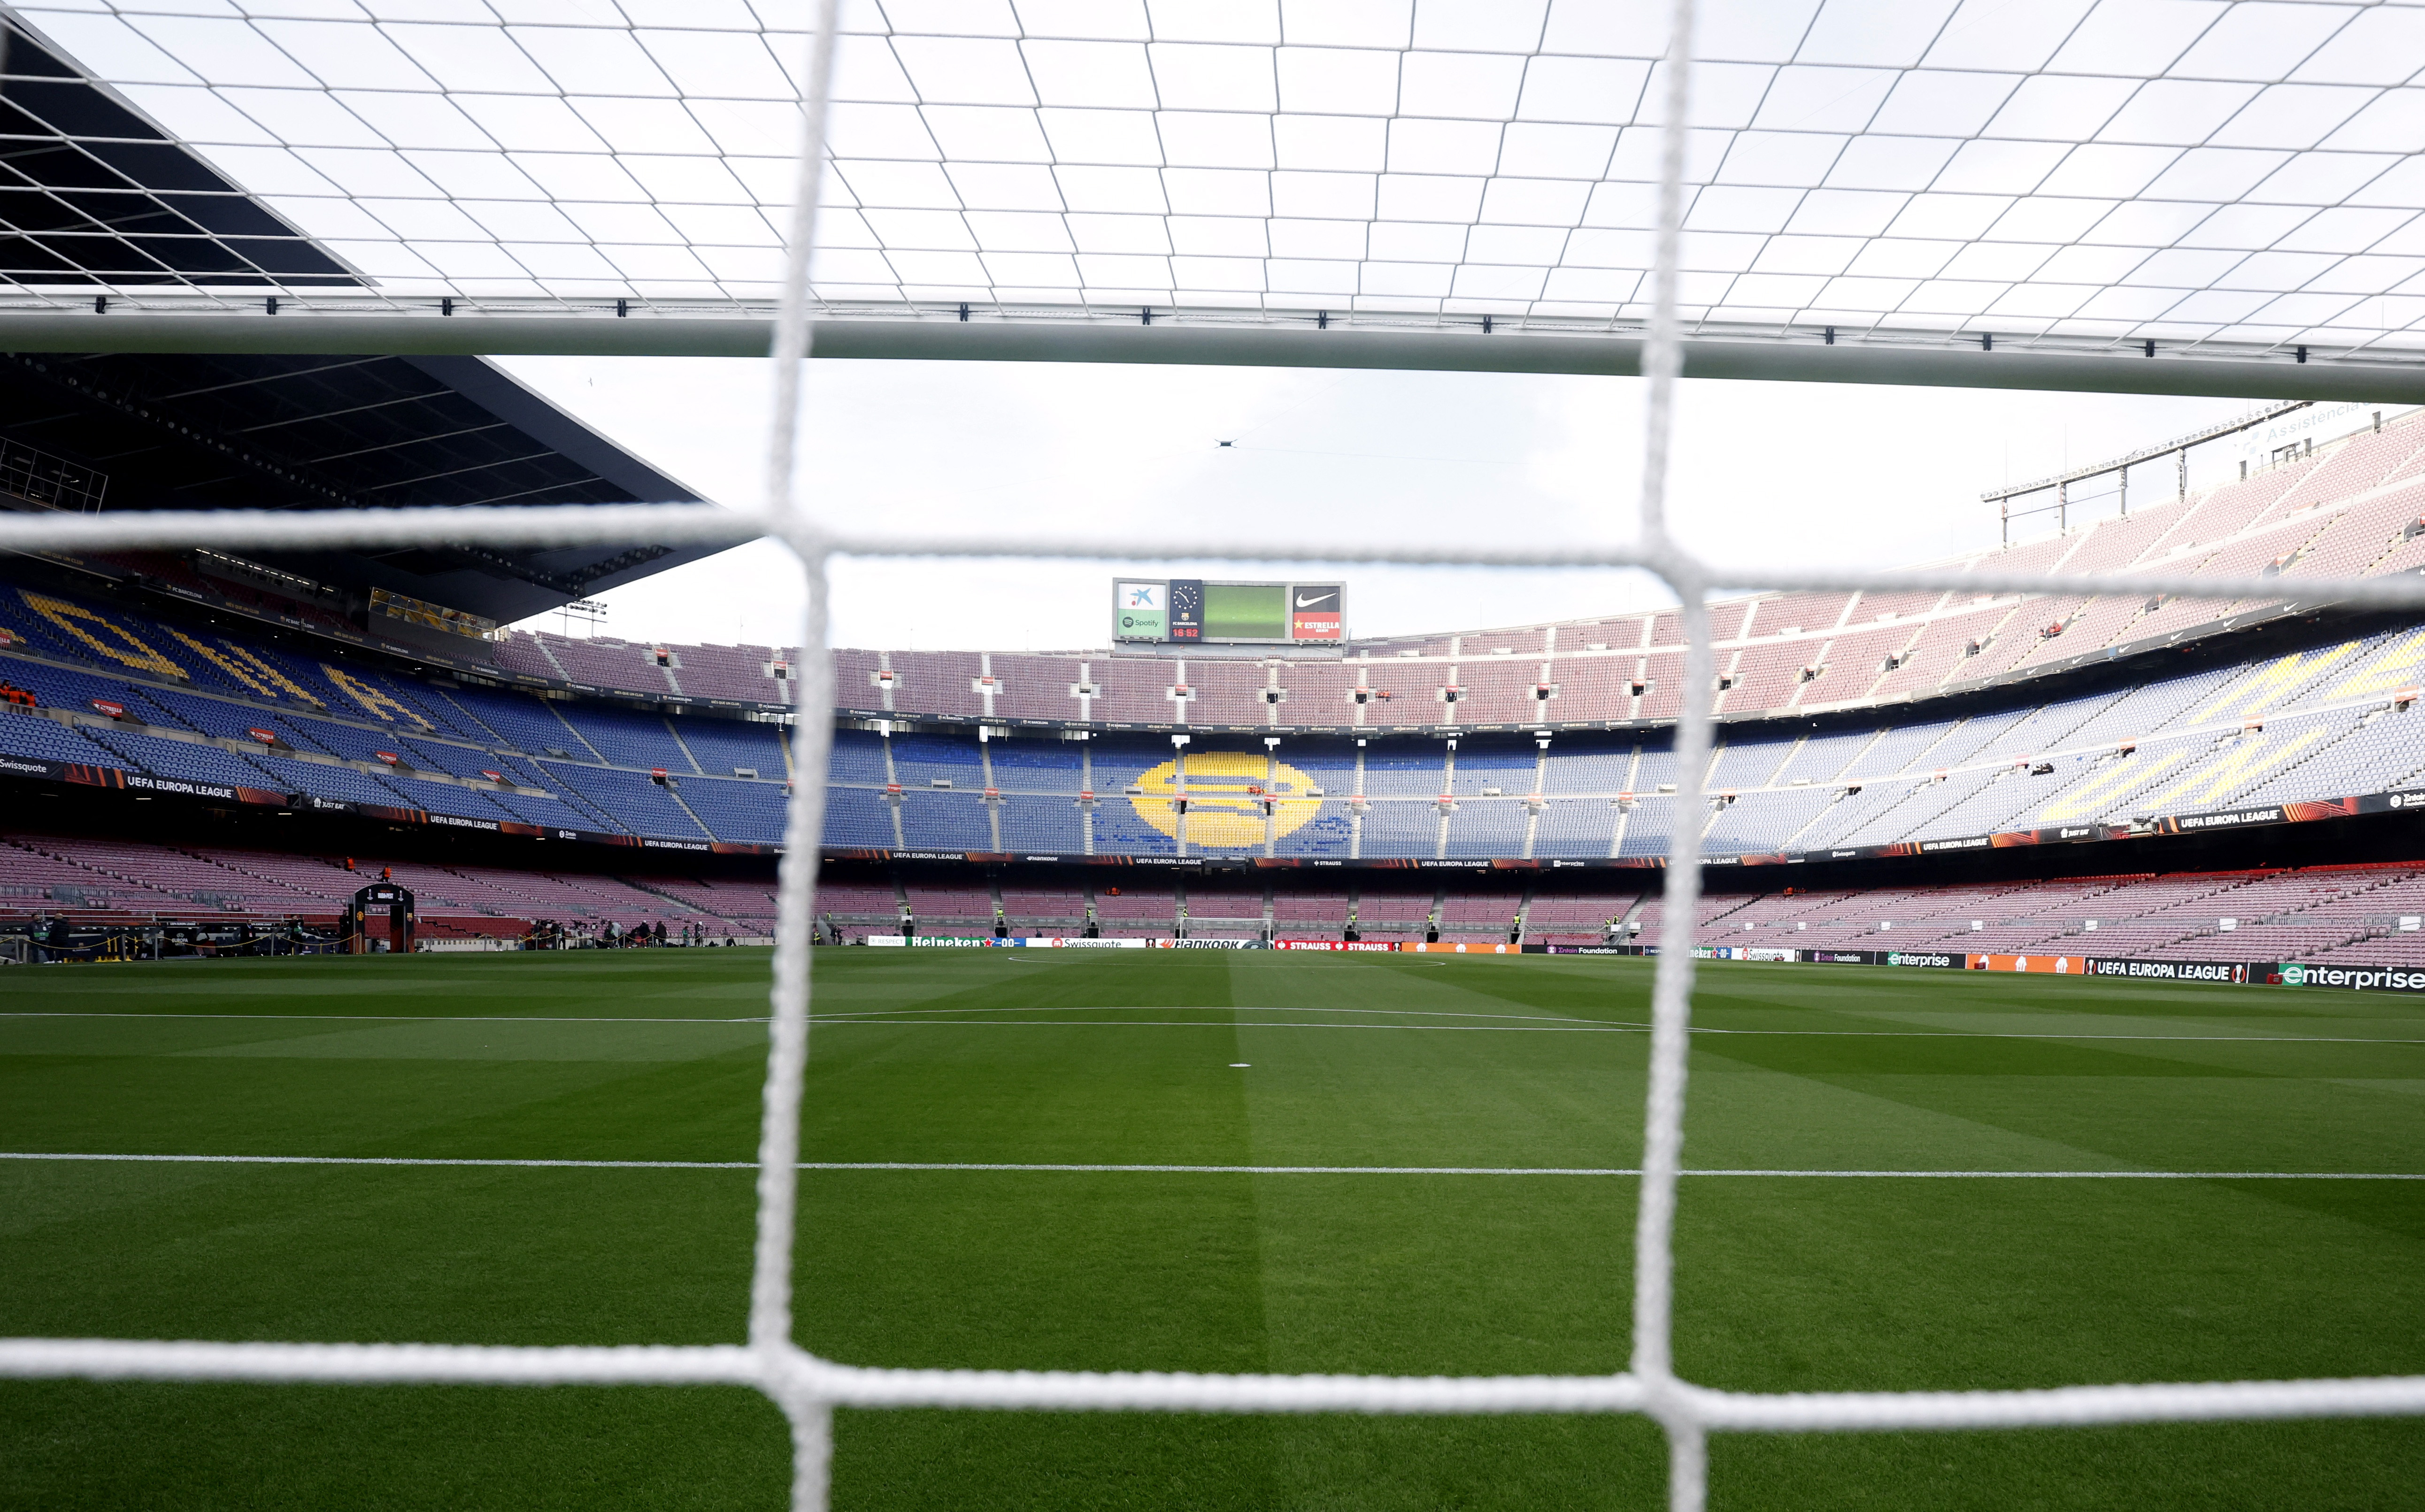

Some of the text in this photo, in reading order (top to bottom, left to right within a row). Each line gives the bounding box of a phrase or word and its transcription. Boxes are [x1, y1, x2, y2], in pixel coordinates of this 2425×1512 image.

[1173, 629, 1198, 637] 16:52
[0, 759, 46, 773] Swissquote
[128, 776, 231, 798] UEFA EUROPA LEAGUE
[431, 815, 497, 830] UEFA EUROPA LEAGUE
[2181, 810, 2278, 828] UEFA EUROPA LEAGUE
[1940, 841, 1963, 849] EUROPA
[1963, 838, 1987, 847] LEAGUE
[912, 937, 980, 947] Heineken
[1065, 939, 1121, 948] Swissquote
[1888, 952, 1950, 967] enterprise
[2097, 962, 2230, 980] UEFA EUROPA LEAGUE
[2278, 967, 2425, 990] enterprise
